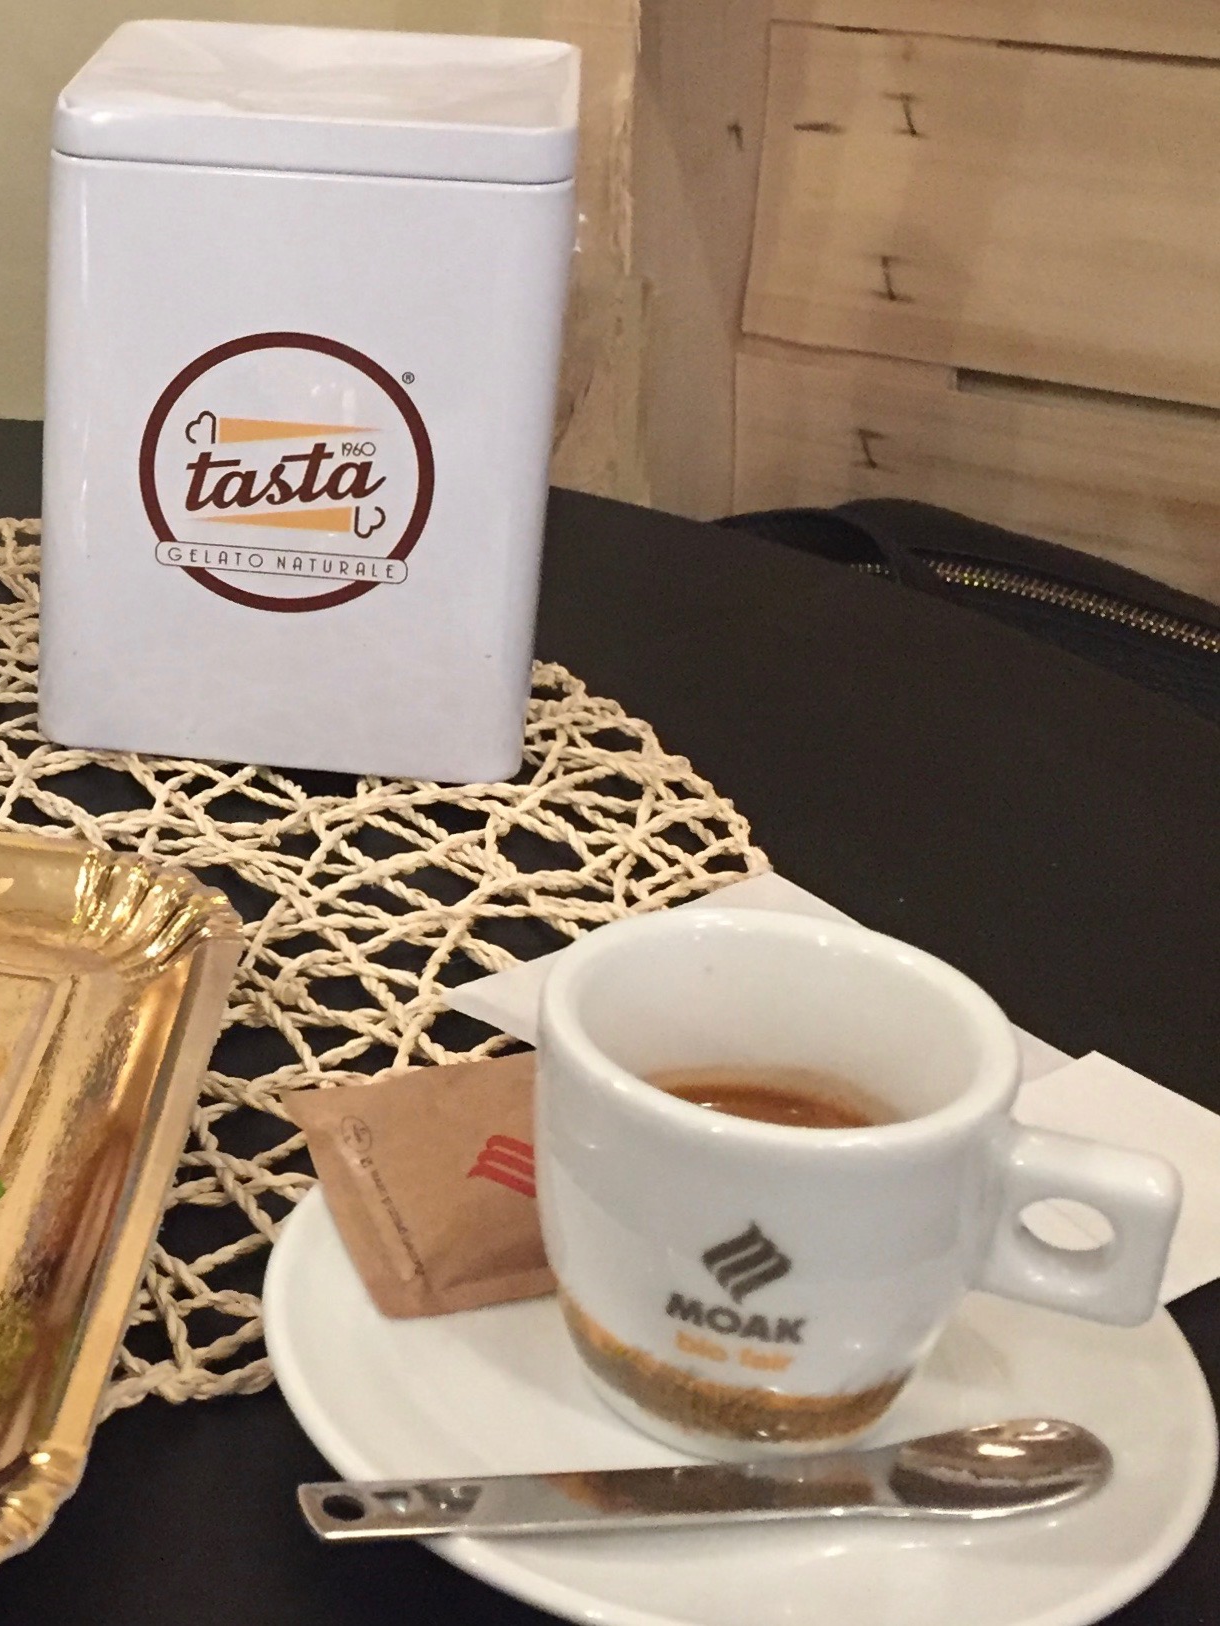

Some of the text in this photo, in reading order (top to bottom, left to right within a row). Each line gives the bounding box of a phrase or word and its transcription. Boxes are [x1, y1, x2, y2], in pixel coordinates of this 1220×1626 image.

[342, 442, 376, 458] 1960
[185, 443, 386, 511] tasta
[168, 546, 395, 579] GELATO NATURALE
[665, 1292, 807, 1345] MOAK
